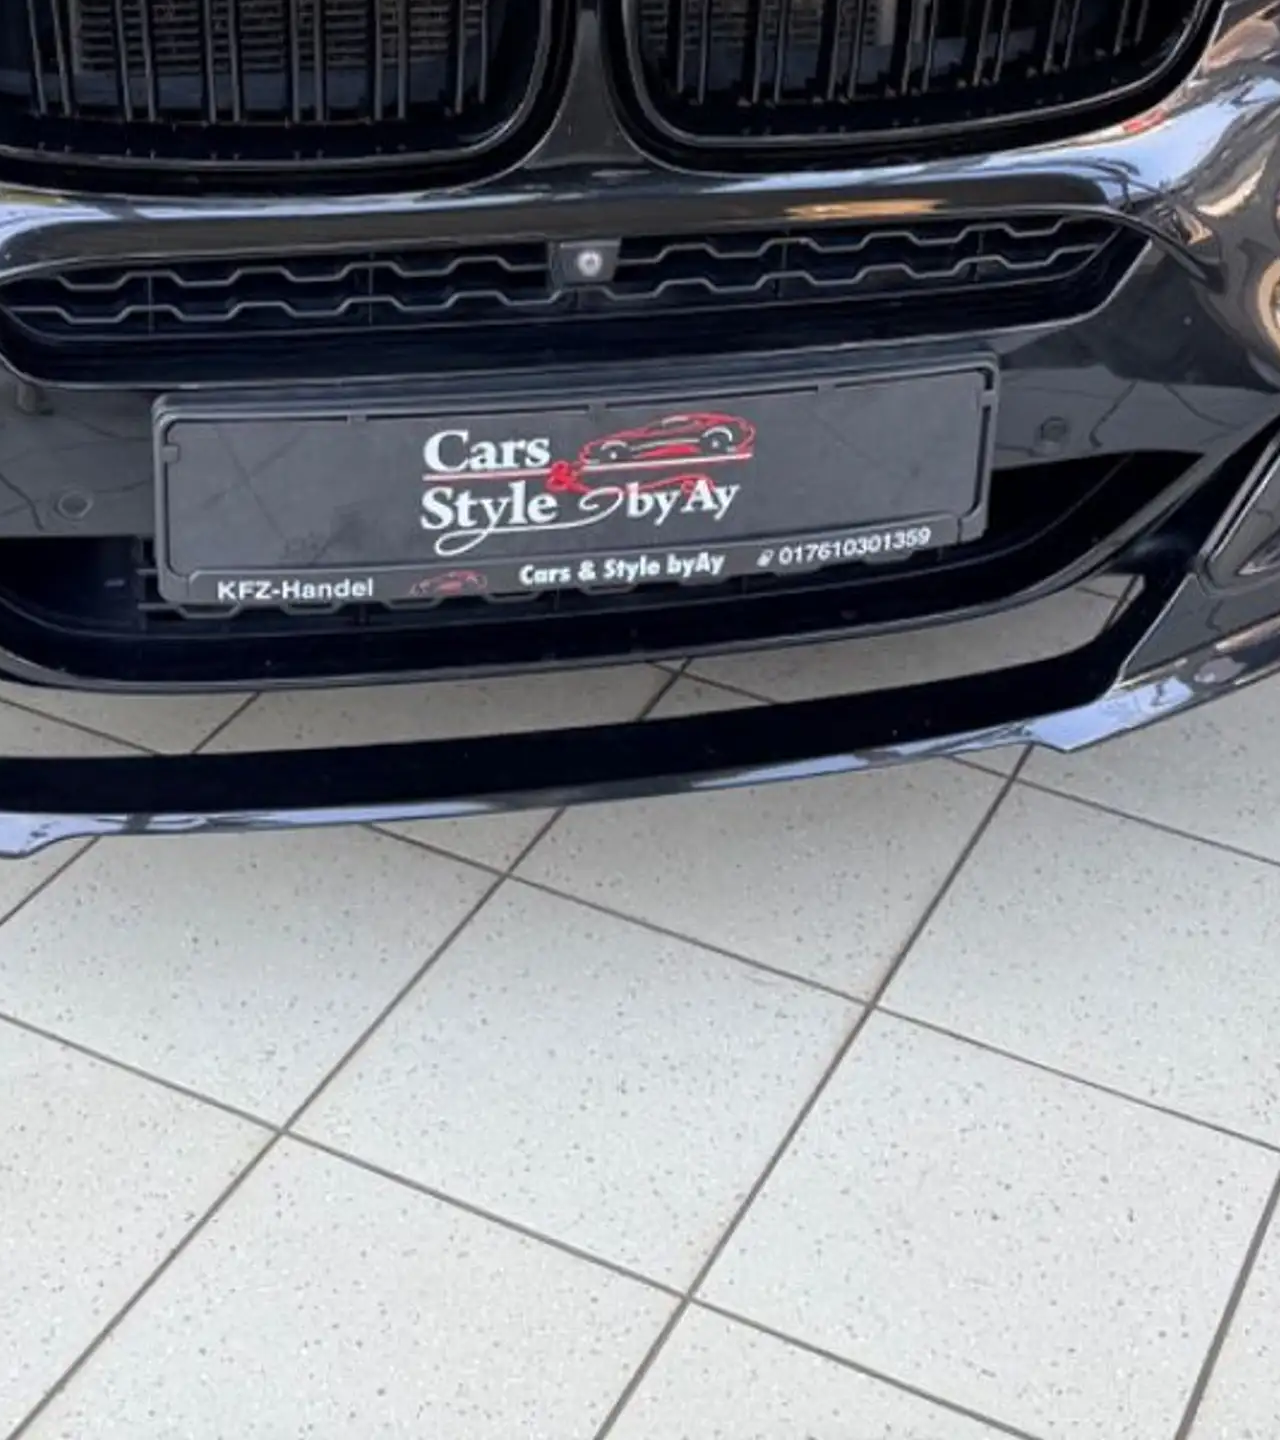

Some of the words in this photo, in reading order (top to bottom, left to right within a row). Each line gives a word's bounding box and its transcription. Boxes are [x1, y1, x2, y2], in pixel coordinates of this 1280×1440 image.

[423, 429, 552, 473] Cars
[545, 460, 584, 493] &
[419, 479, 559, 557] Style
[216, 578, 374, 602] KFZ-Handel
[519, 564, 572, 586] Cars
[577, 560, 598, 582] &
[604, 555, 661, 579] Style
[778, 525, 933, 566] 017610301359
